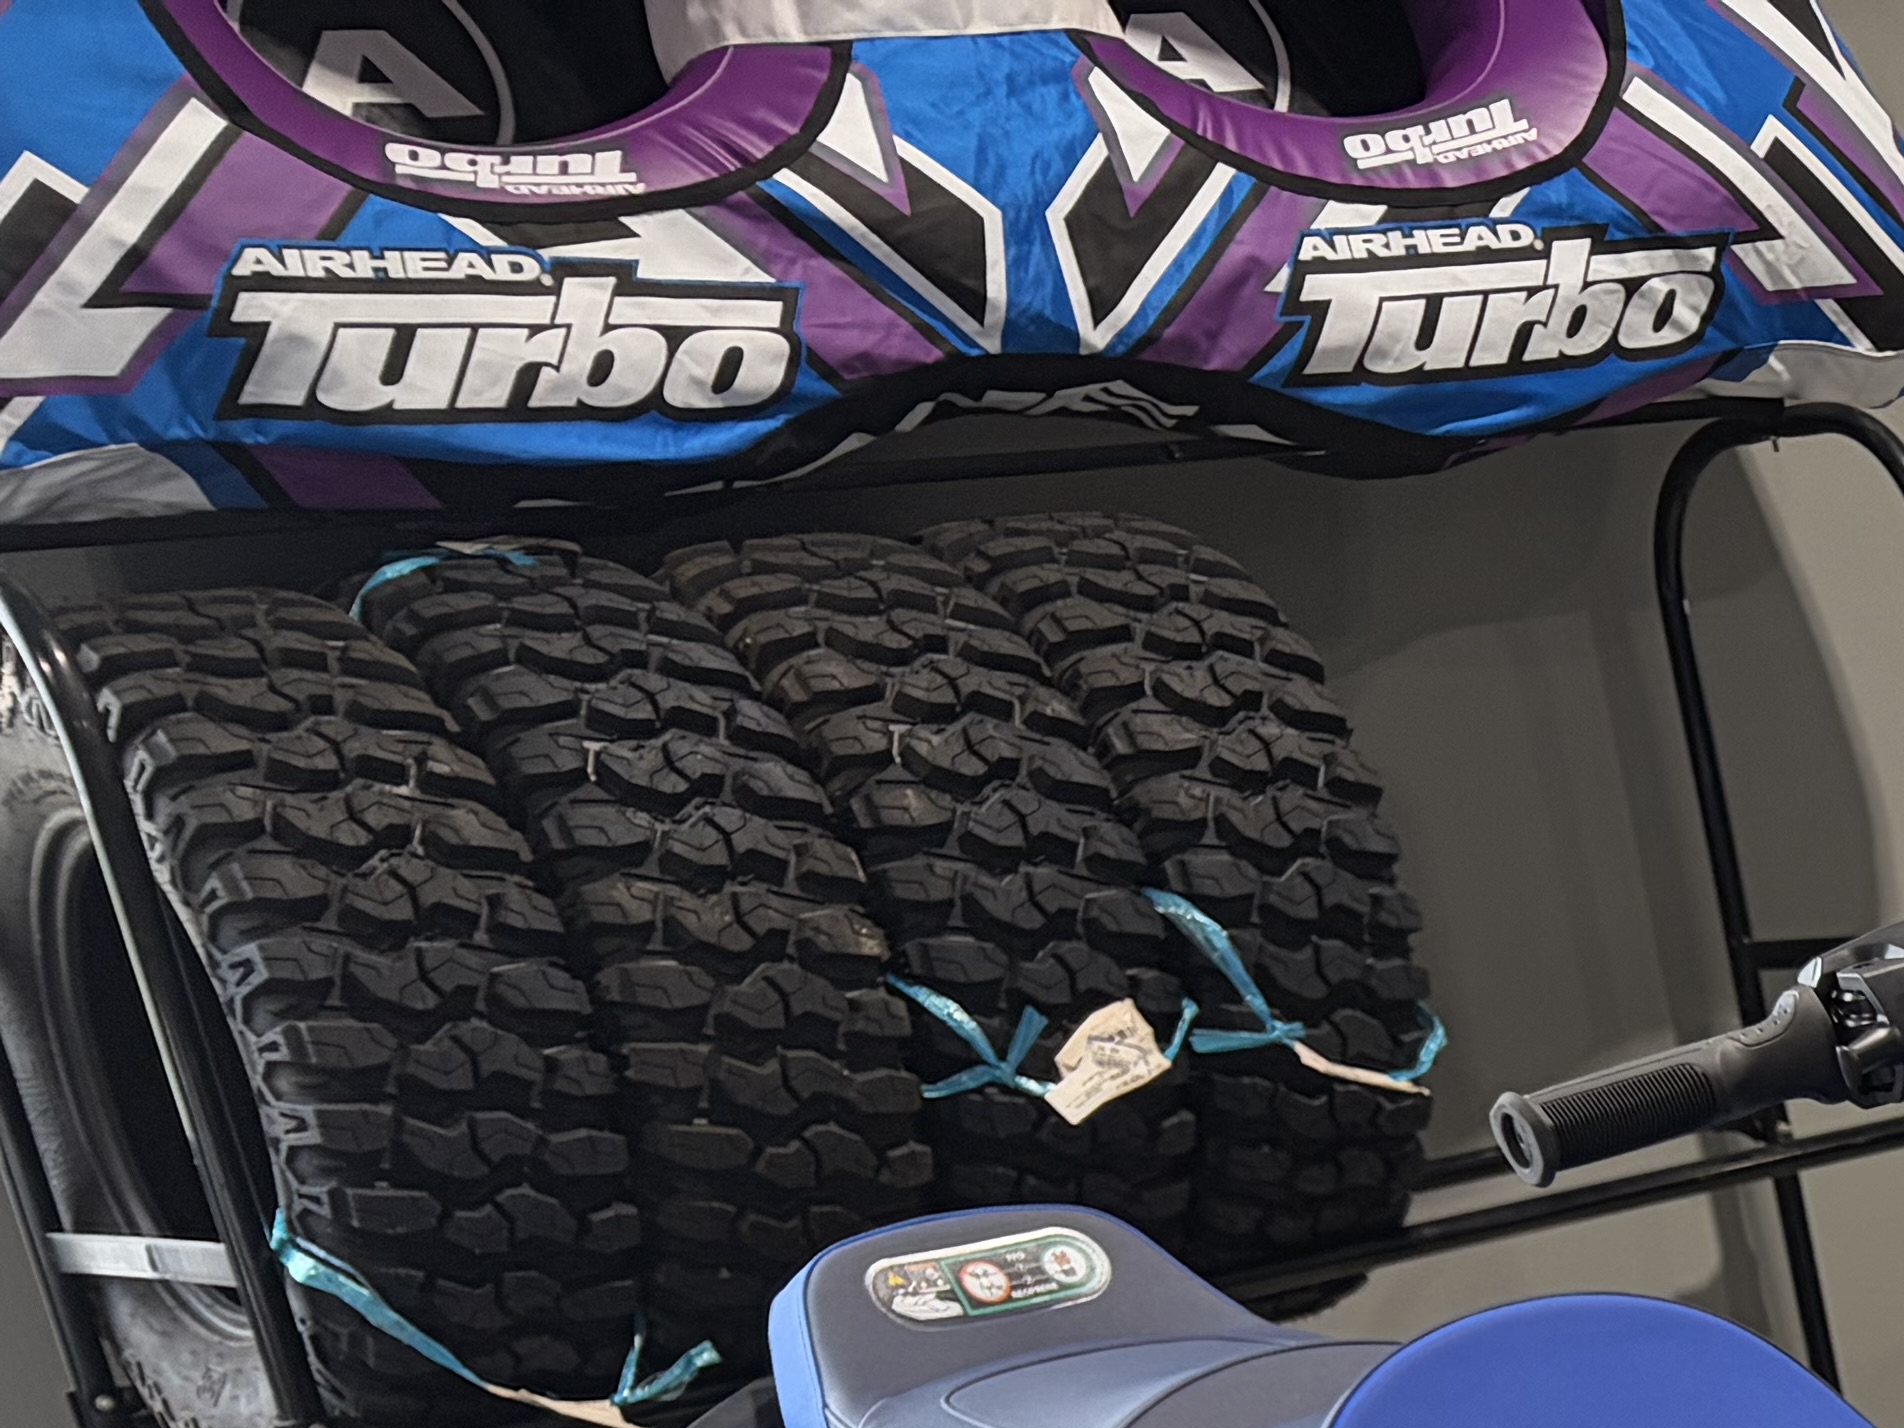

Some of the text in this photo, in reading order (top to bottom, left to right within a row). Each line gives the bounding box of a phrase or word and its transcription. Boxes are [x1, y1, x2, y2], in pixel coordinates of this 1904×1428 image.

[1344, 97, 1519, 170] Turbo
[384, 141, 637, 189] Turbo
[230, 246, 553, 283] AIRHEAD
[1297, 222, 1542, 261] AIRHEAD
[1295, 239, 1718, 376] Turbo
[231, 275, 785, 412] Turbo
